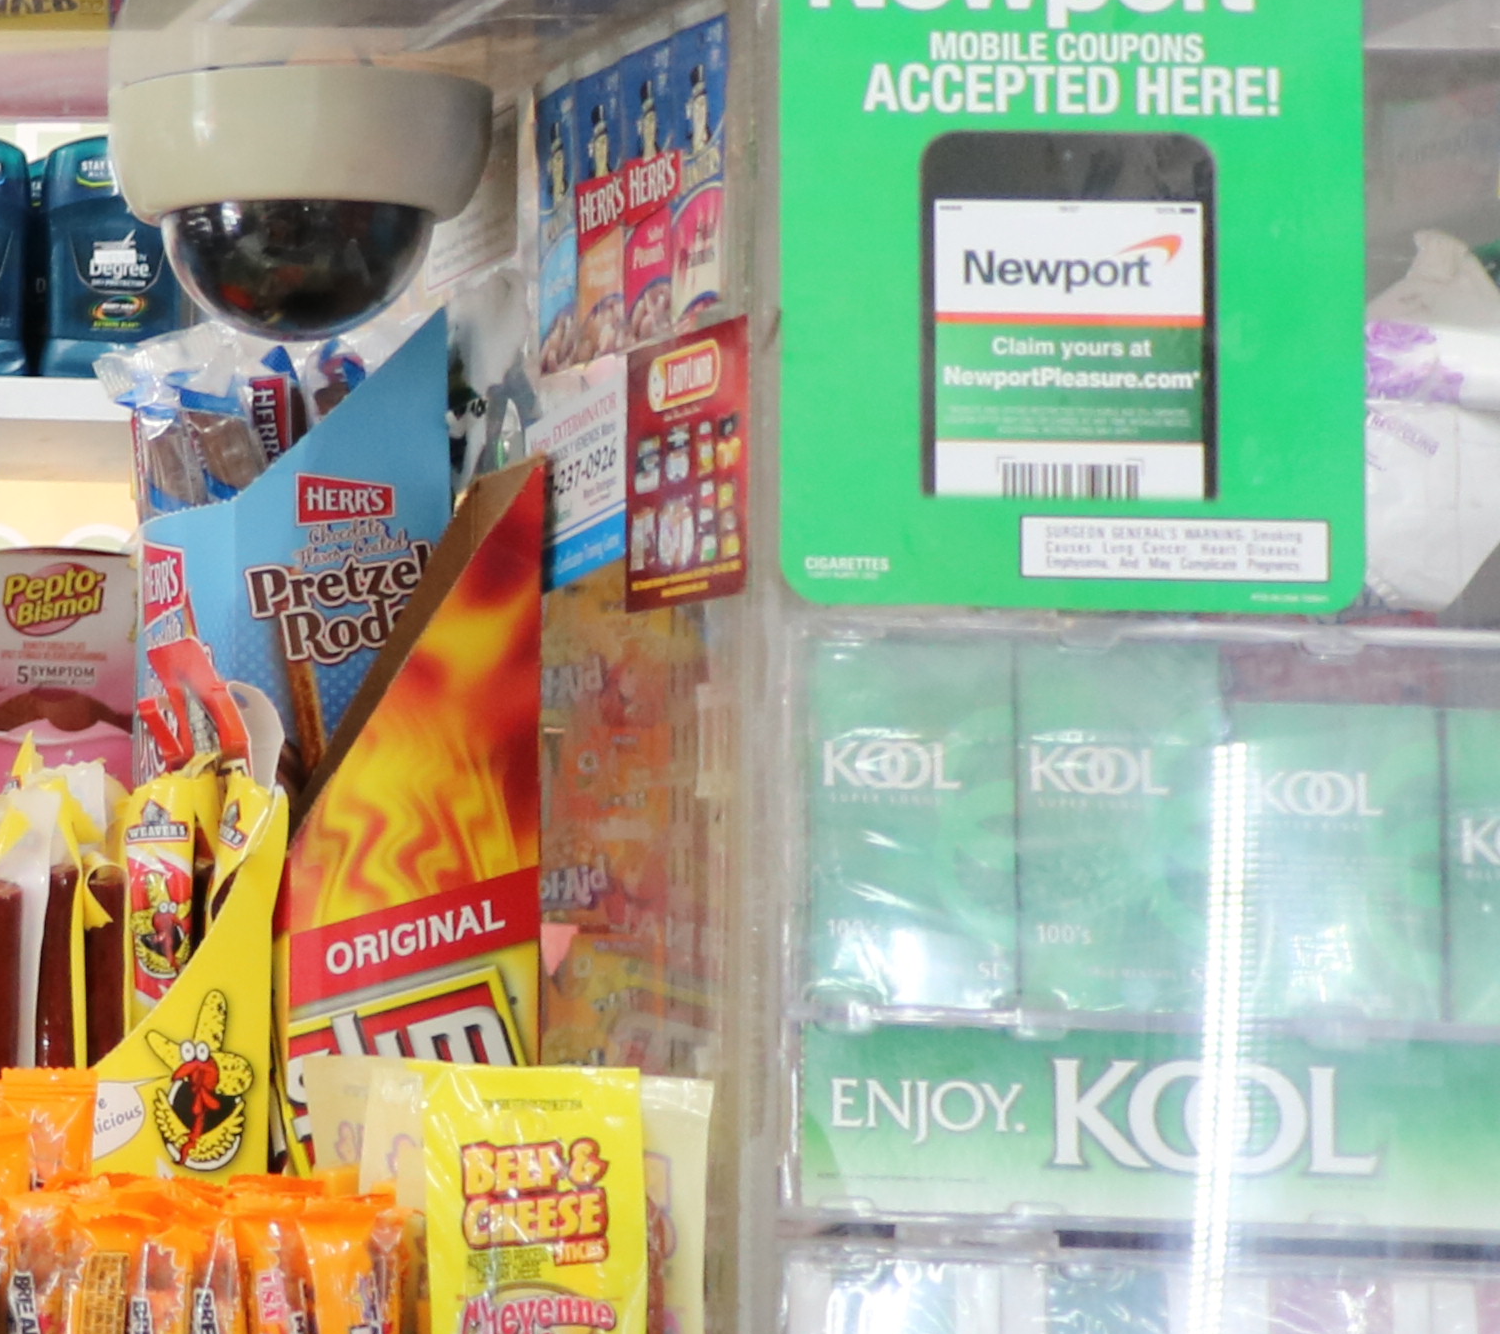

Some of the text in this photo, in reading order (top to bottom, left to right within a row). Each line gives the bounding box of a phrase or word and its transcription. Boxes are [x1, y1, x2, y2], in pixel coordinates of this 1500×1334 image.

[929, 32, 1204, 64] MOBILE COUPONS
[863, 64, 1282, 116] ACCEPTED HERE!
[962, 249, 1151, 293] Newport
[991, 336, 1152, 362] Claim yours at
[306, 483, 385, 512] HERR'S
[3, 566, 105, 606] Pepto-
[15, 594, 103, 625] Bismol
[325, 900, 506, 974] ORIGINAL
[830, 1078, 1027, 1144] ENJOY.
[1050, 1059, 1381, 1179] KOOL
